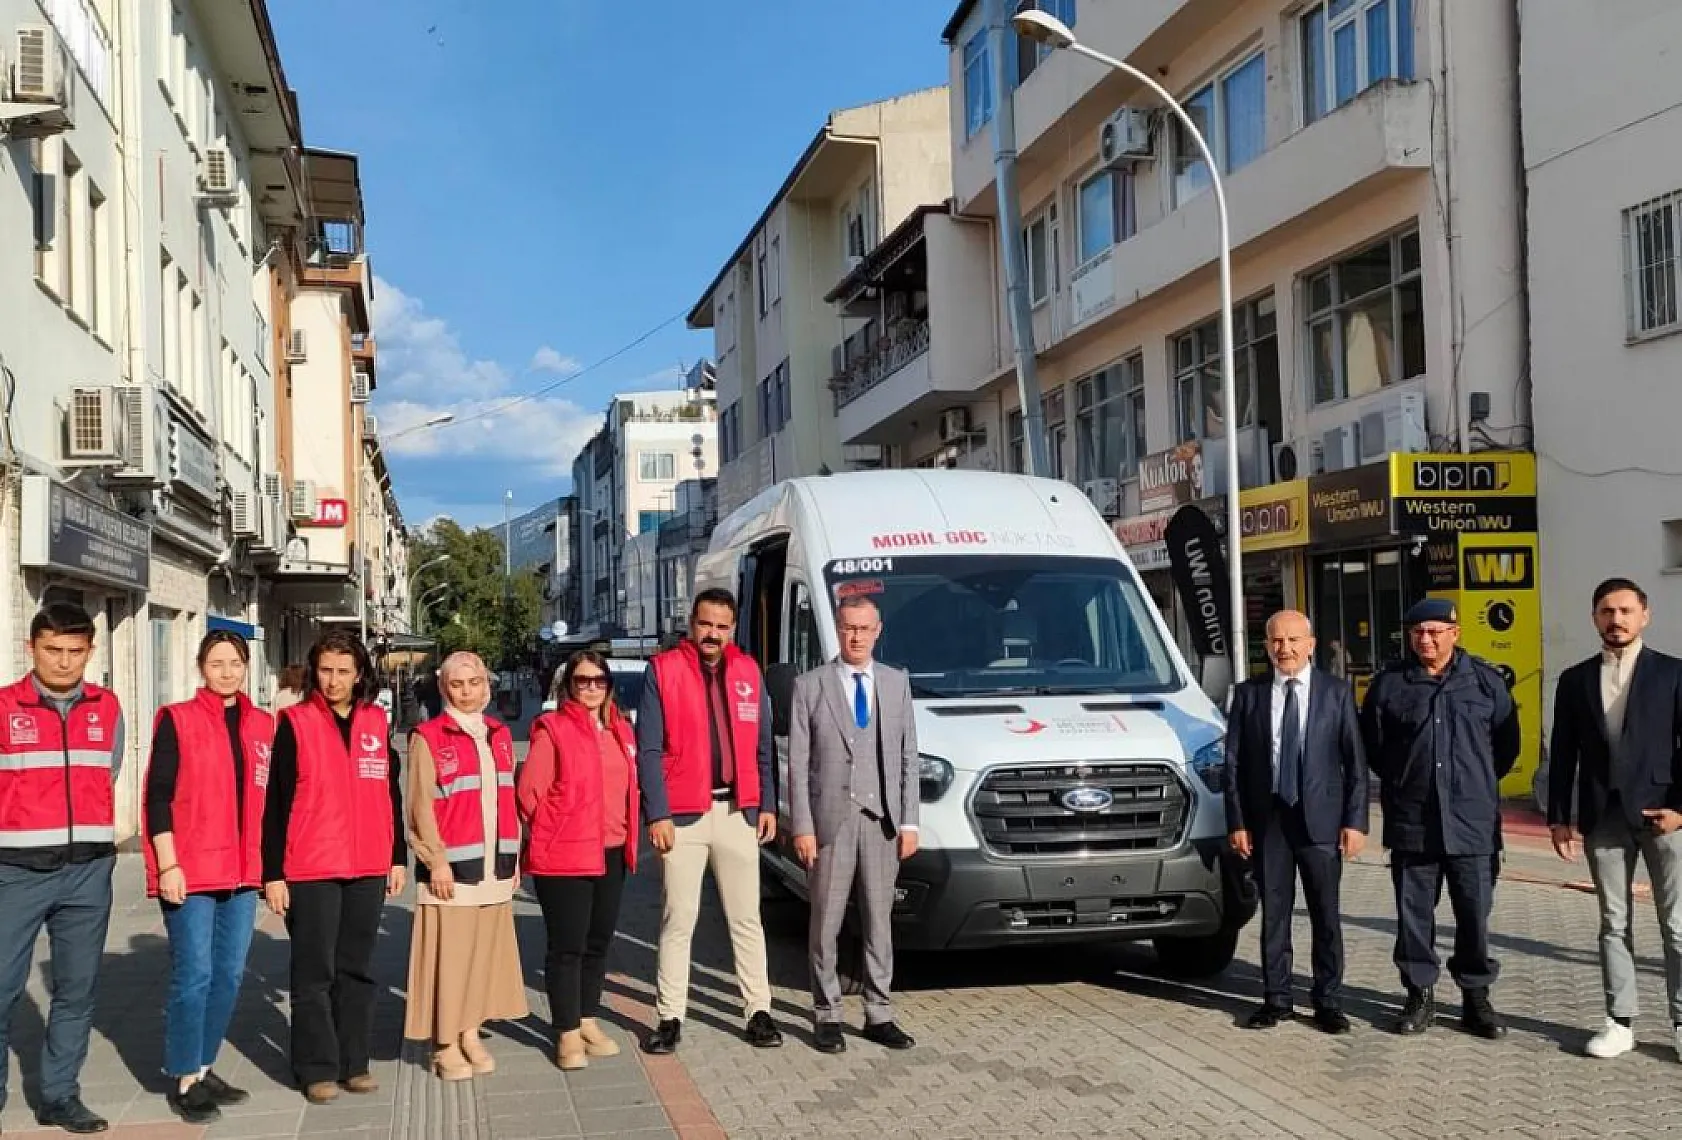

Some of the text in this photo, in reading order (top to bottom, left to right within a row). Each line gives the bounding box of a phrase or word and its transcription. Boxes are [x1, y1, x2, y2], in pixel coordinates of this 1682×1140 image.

[1417, 460, 1492, 492] bpn
[1313, 489, 1359, 508] Western
[1405, 499, 1477, 514] Western
[1242, 503, 1289, 536] bpn
[1428, 514, 1477, 531] Union
[832, 557, 893, 574] 48/001
[1468, 553, 1525, 583] WU
